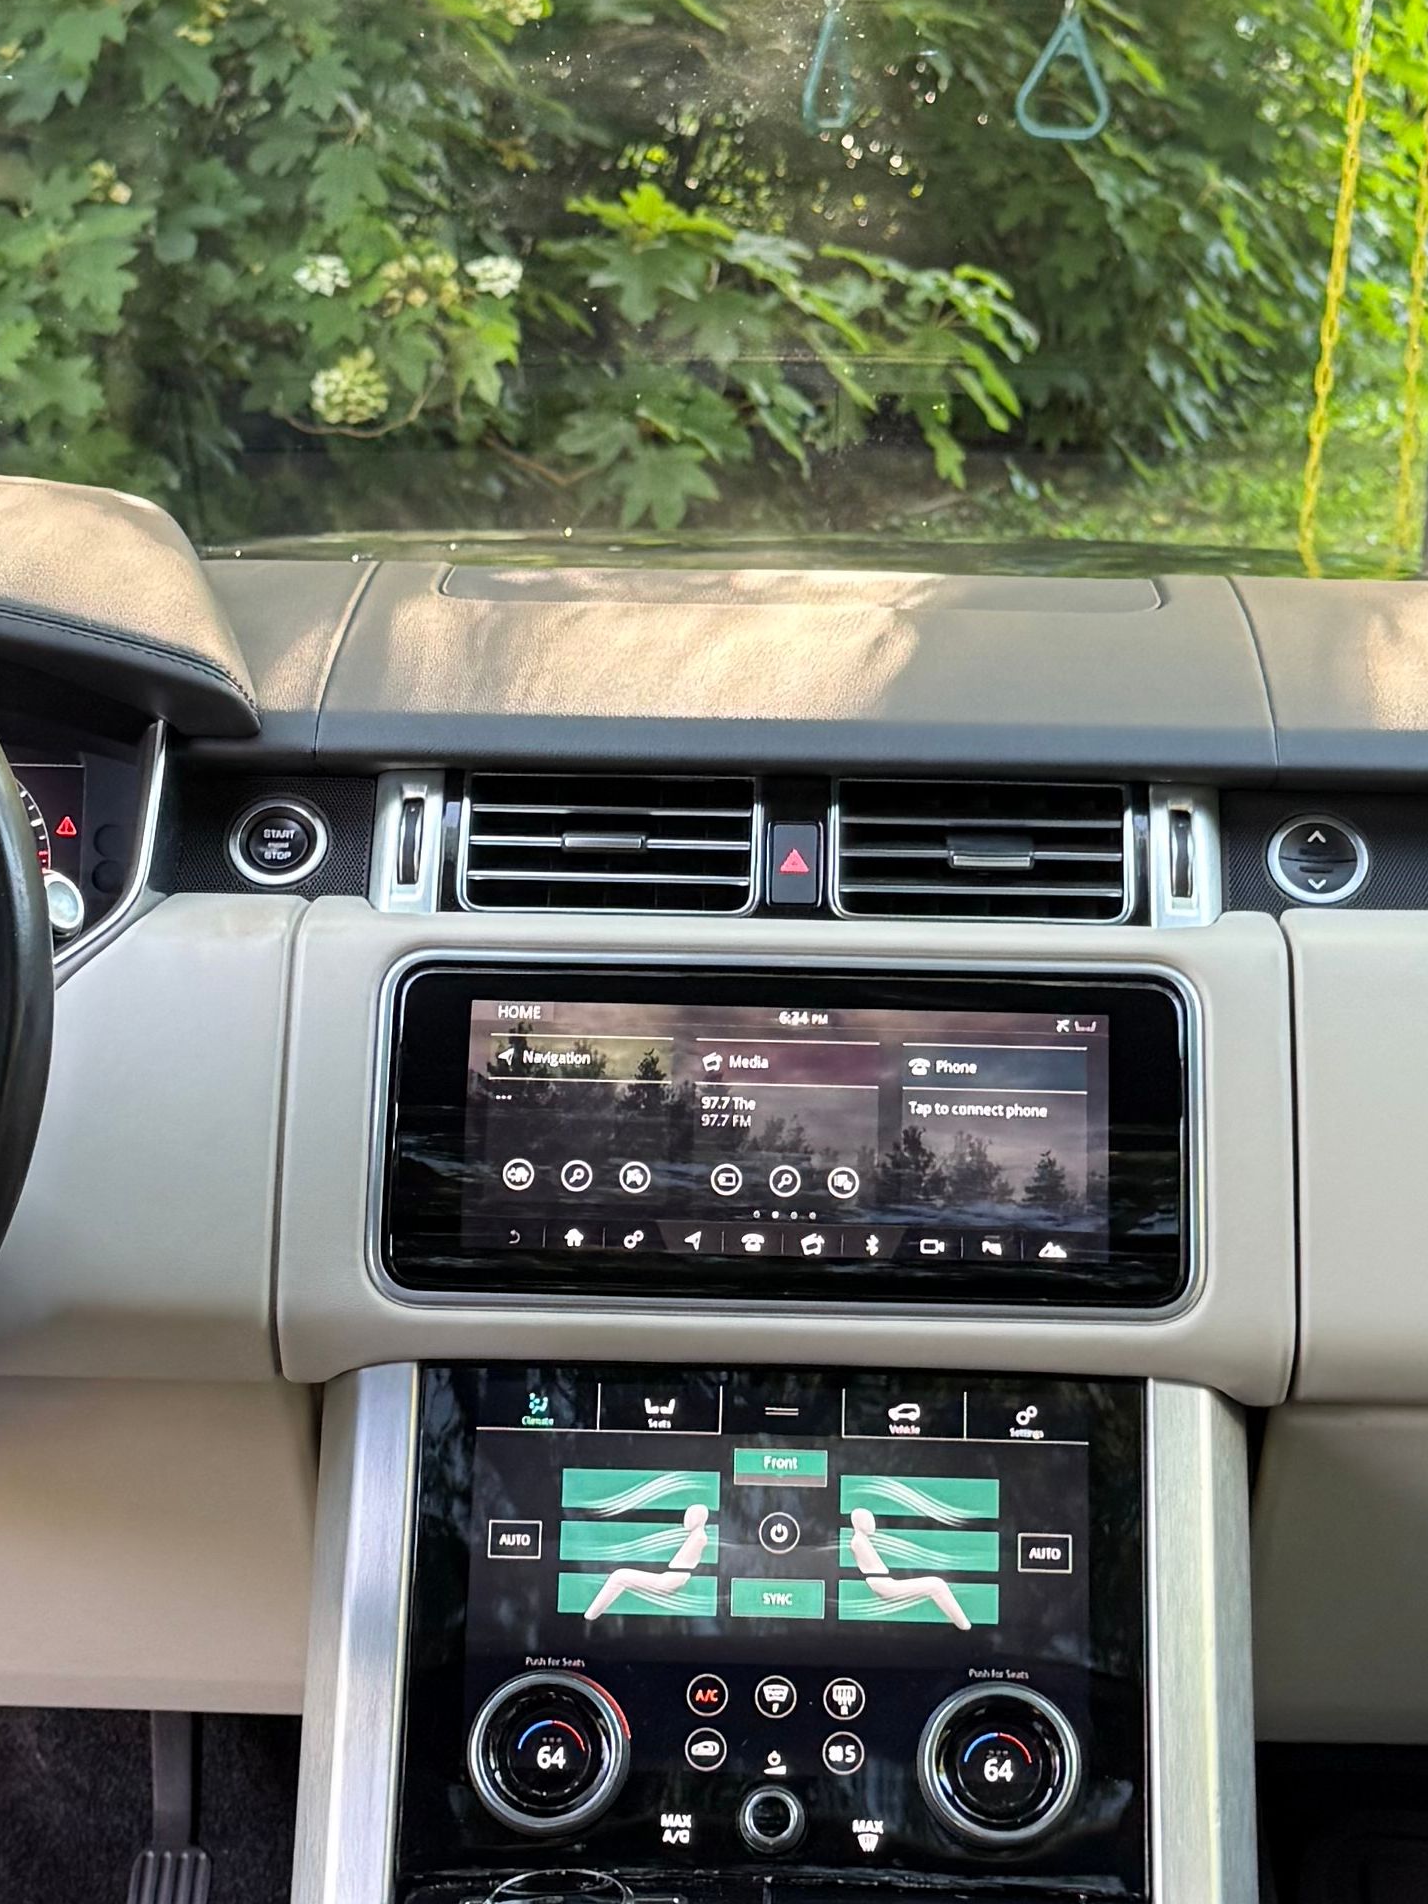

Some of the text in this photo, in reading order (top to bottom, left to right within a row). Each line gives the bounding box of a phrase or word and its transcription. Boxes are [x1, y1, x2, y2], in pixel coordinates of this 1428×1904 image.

[263, 828, 296, 839] START
[263, 850, 292, 860] STOP
[497, 1004, 541, 1020] HOME
[778, 1010, 829, 1026] 6:34 PM
[522, 1050, 592, 1068] Navigation
[728, 1055, 770, 1070] Media
[935, 1059, 978, 1075] Phone
[701, 1095, 757, 1111] 97.7 The
[908, 1100, 1048, 1119] Tap to connect phone
[701, 1113, 752, 1128] 97.7 FM
[647, 1417, 672, 1429] Seats
[763, 1455, 798, 1471] Front
[498, 1533, 531, 1547] AUTO
[1028, 1546, 1062, 1561] AUTO
[762, 1592, 793, 1607] SYNC
[561, 1657, 586, 1668] Seats
[1005, 1669, 1030, 1680] Seats
[695, 1688, 719, 1702] A/C
[536, 1745, 567, 1770] 64
[845, 1745, 857, 1763] 5
[983, 1758, 1014, 1783] 64
[660, 1813, 692, 1828] MAX
[852, 1819, 884, 1834] MAX
[662, 1829, 690, 1844] A/C
